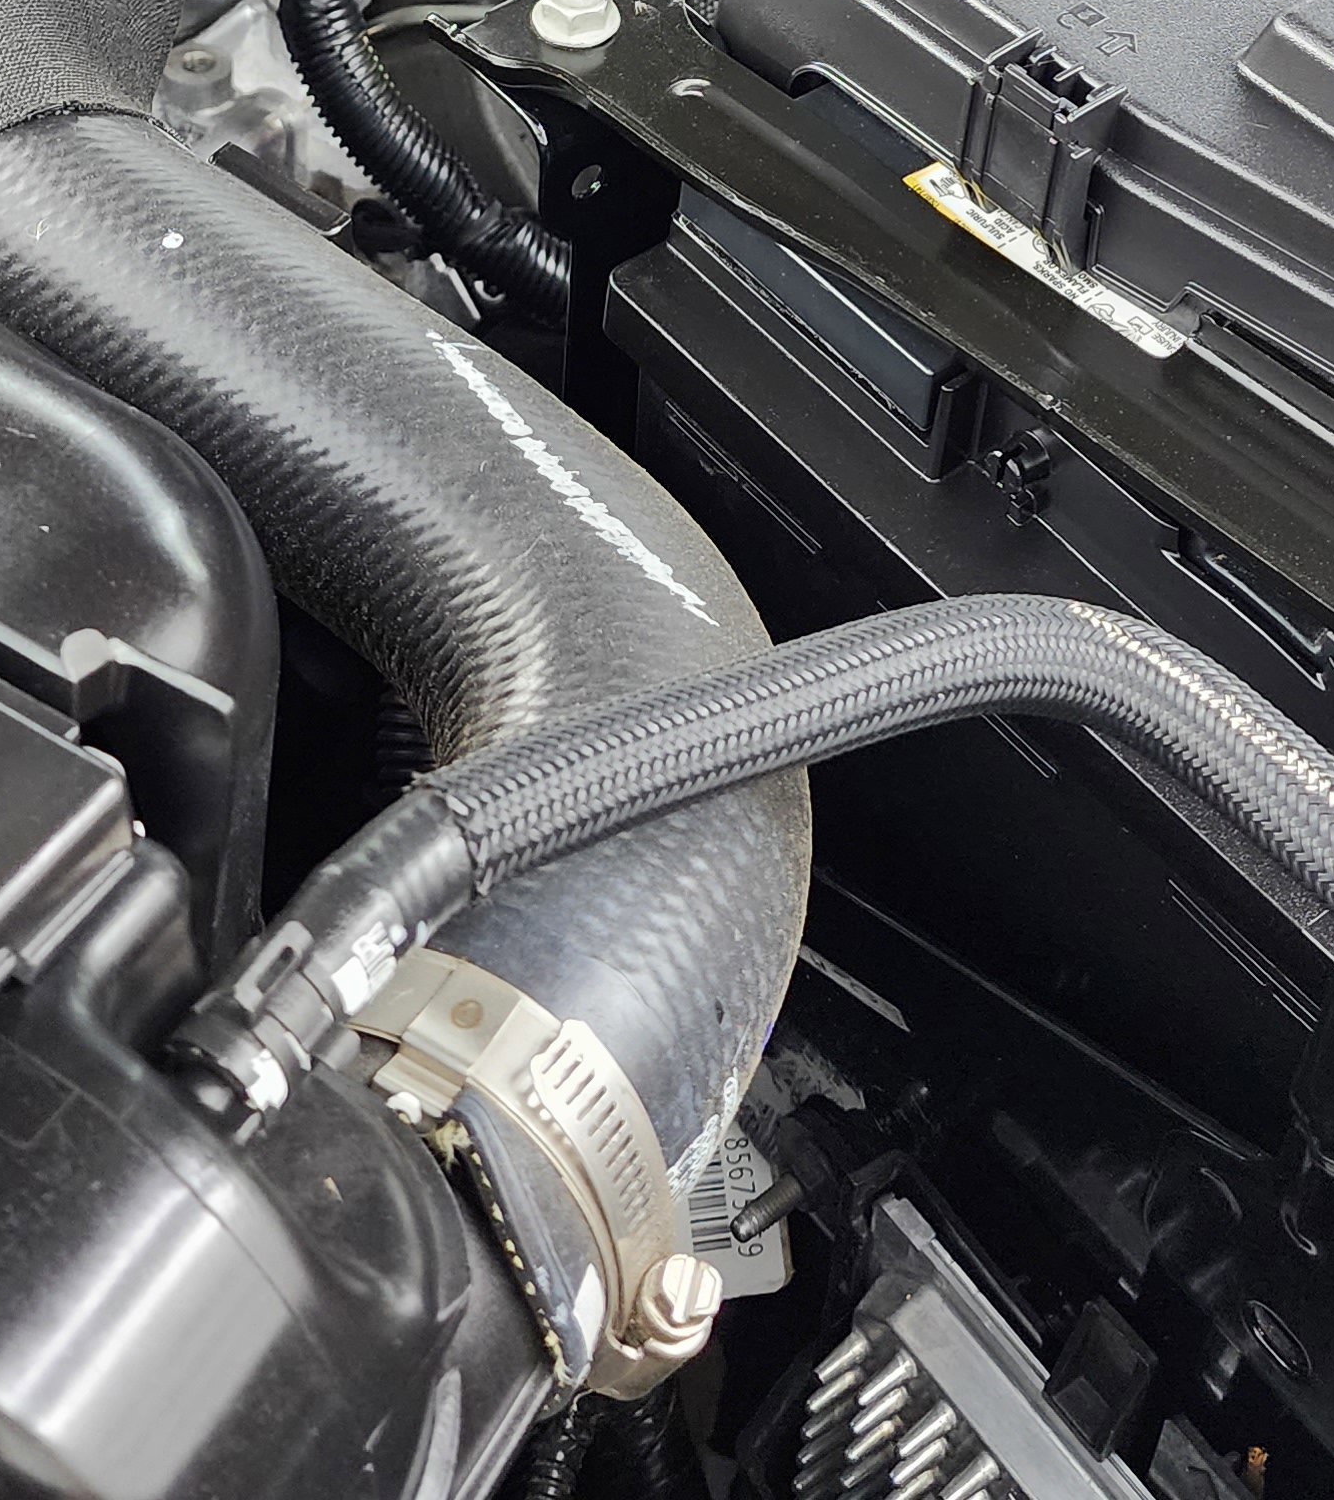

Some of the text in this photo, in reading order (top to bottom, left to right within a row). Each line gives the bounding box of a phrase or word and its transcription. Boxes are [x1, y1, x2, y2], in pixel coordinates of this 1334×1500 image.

[964, 207, 1006, 241] SULFURIC
[993, 217, 1015, 235] ACID
[1032, 260, 1080, 301] NO SPARKS,
[1152, 320, 1181, 343] INJURY
[723, 1136, 765, 1258] 856759
